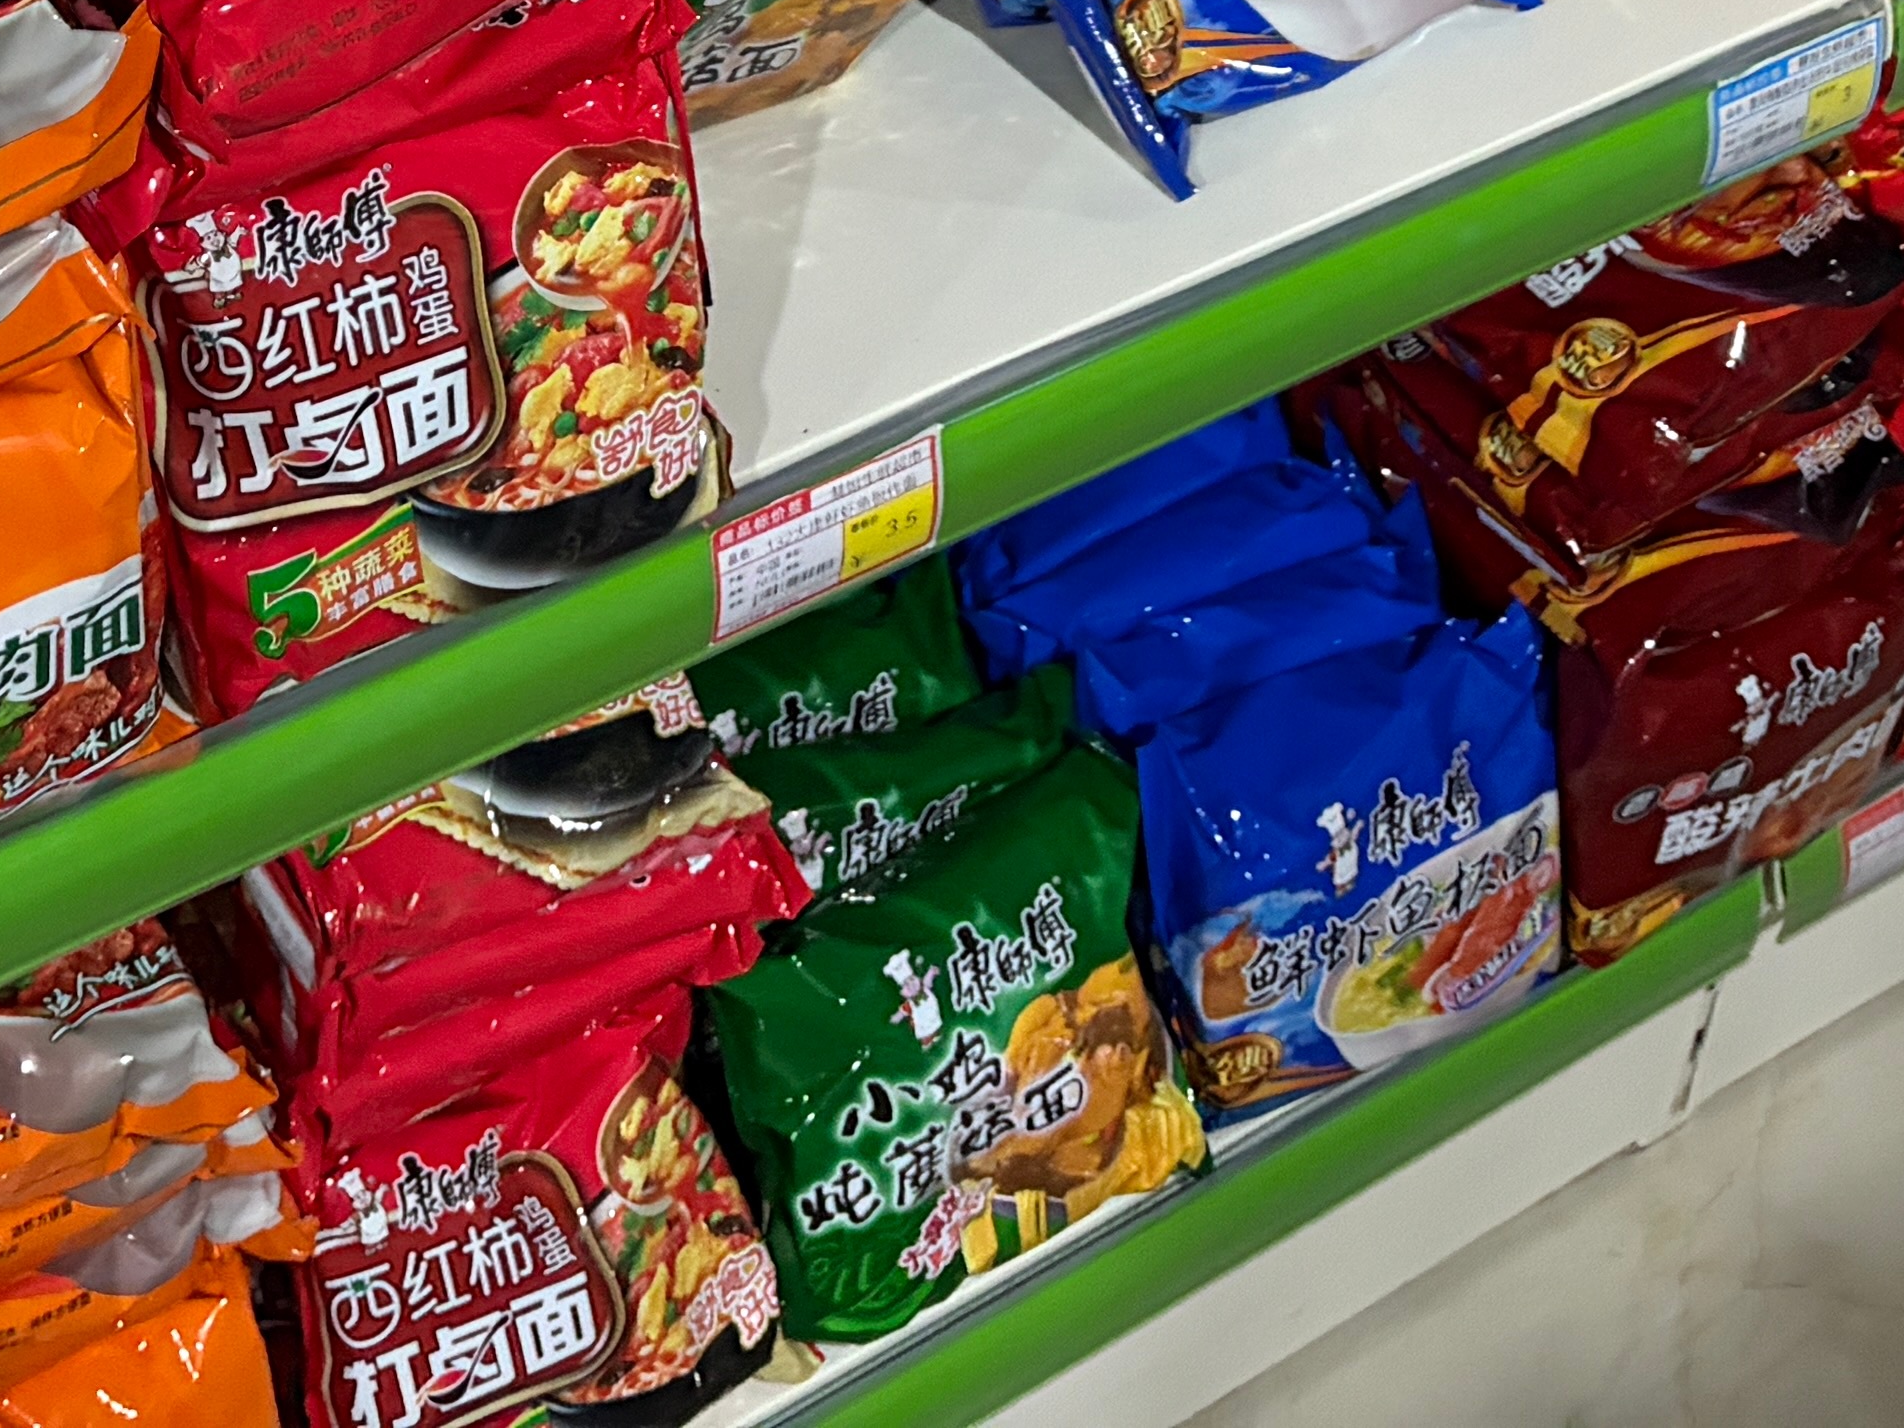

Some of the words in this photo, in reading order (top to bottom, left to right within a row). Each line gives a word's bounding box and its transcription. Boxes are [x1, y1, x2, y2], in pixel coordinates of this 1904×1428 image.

[254, 165, 392, 286] 康師傅
[181, 274, 408, 403] 西红柿
[402, 245, 461, 345] 鸡蛋
[188, 346, 472, 502] 打卤面
[948, 878, 1076, 1014] 康師傅
[1244, 818, 1546, 1009] 鲜虾鱼板面
[841, 1031, 1005, 1140] 小鸡
[324, 1215, 536, 1348] 西红柿
[346, 1274, 599, 1428] 打卤面
